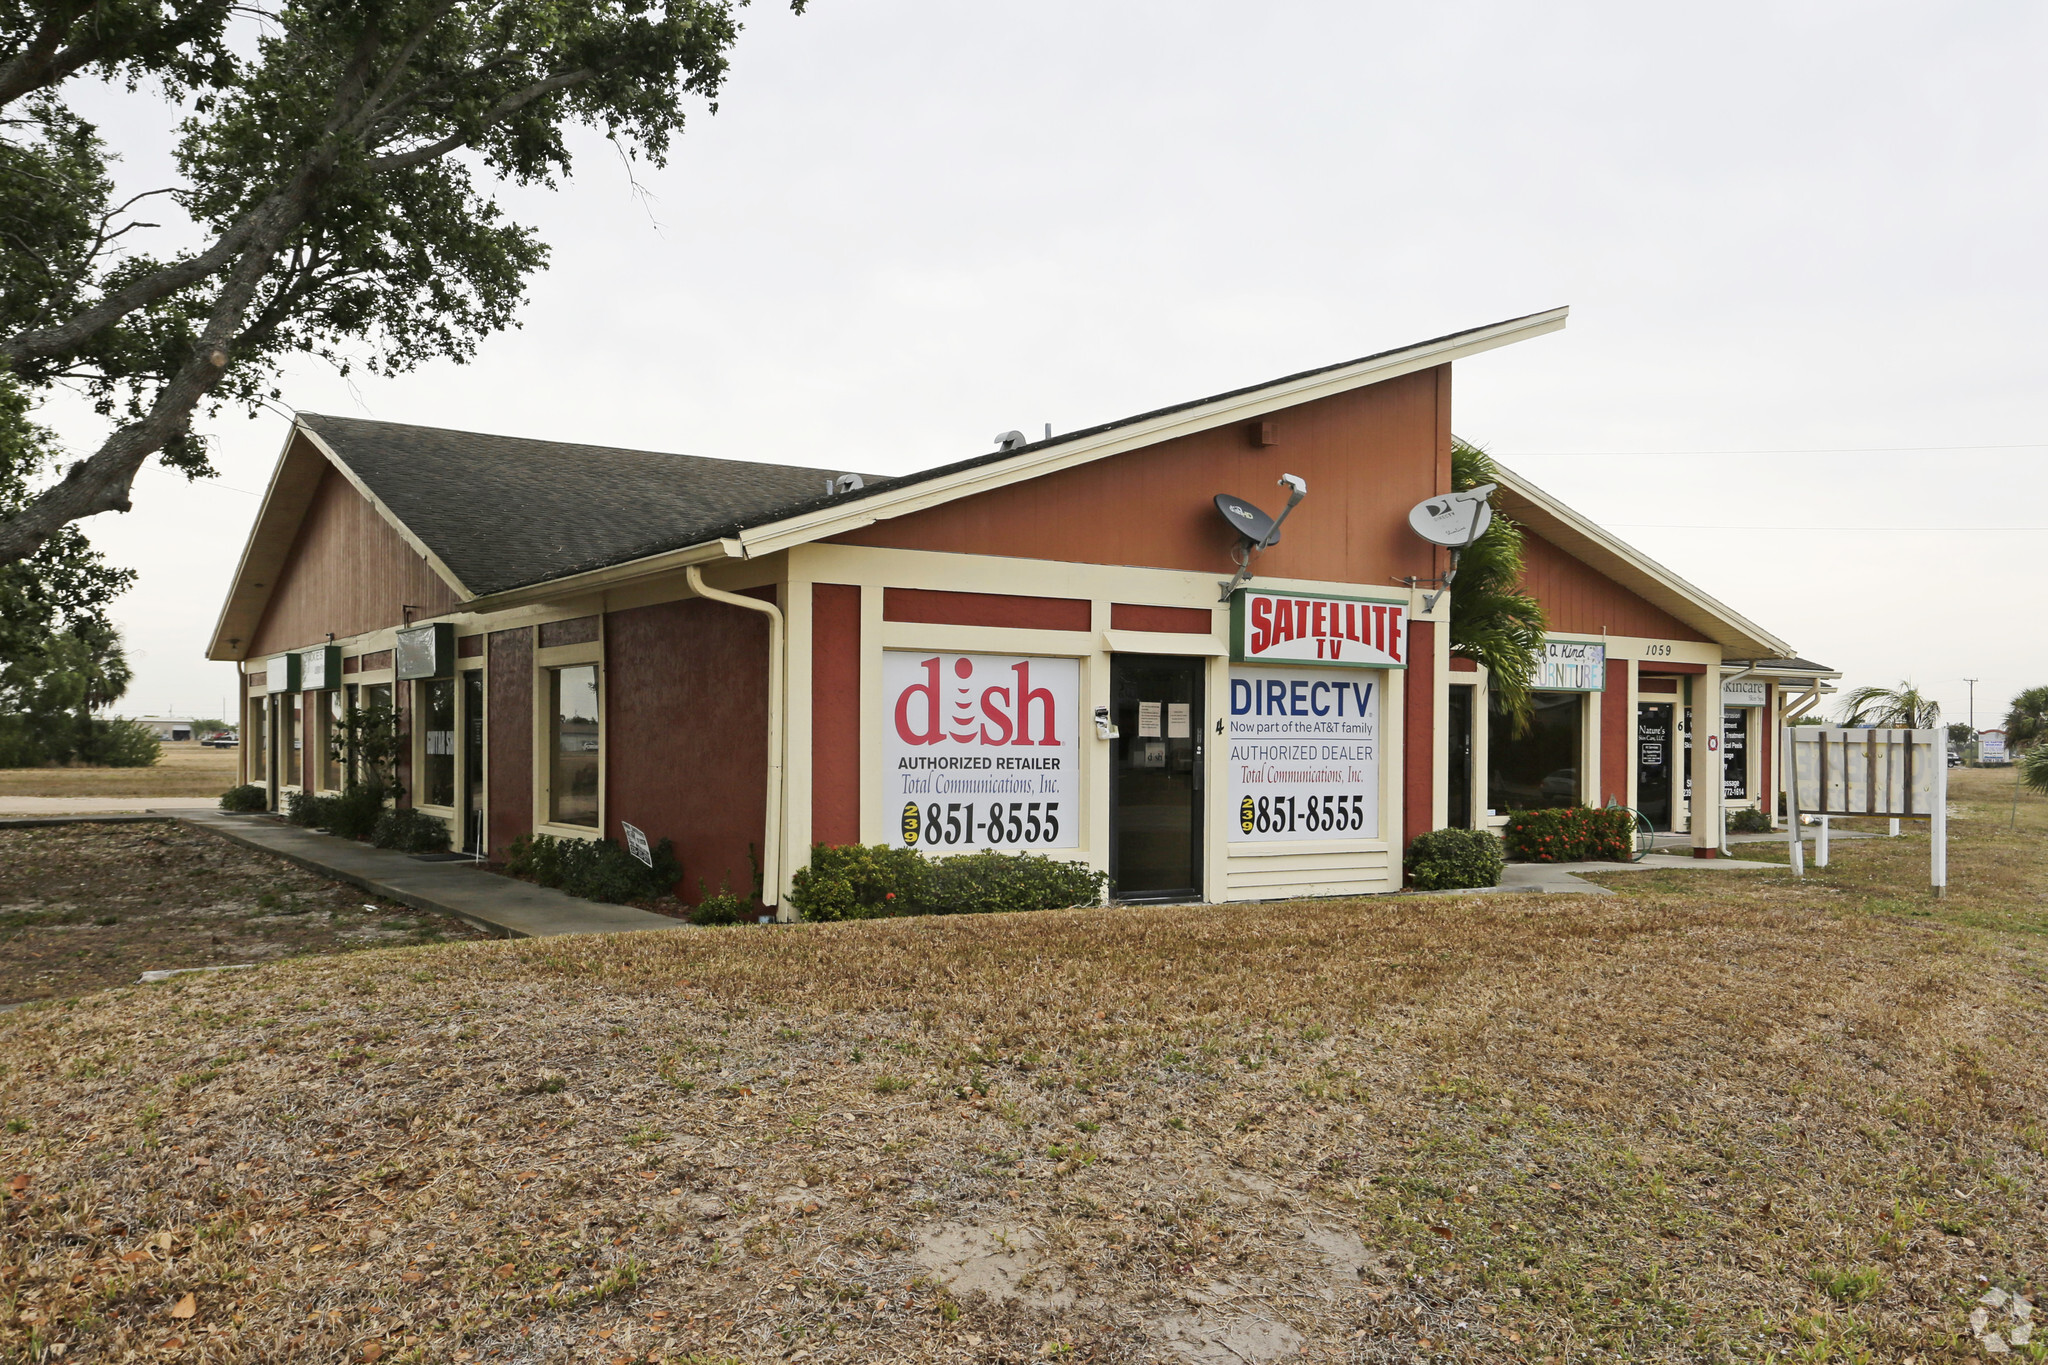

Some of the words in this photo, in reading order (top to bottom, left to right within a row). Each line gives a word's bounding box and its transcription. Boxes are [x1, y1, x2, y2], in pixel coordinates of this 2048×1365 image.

[1251, 597, 1402, 663] SATELLITE
[1316, 638, 1342, 659] TV
[1550, 644, 1558, 657] a
[1561, 644, 1587, 659] Kind
[1646, 644, 1671, 656] 1059
[1534, 663, 1599, 689] URNITURE
[1230, 678, 1373, 718] DIRECTV
[1724, 681, 1763, 694] kincare
[894, 656, 1061, 746] dish
[1215, 717, 1225, 735] 4
[1230, 721, 1255, 732] Now
[1257, 722, 1280, 735] part
[1281, 721, 1293, 733] of
[1295, 722, 1312, 733] the
[1313, 722, 1340, 733] AT&T
[1342, 722, 1373, 736] family
[1639, 724, 1666, 735] Nature's
[1677, 721, 1683, 732] 6
[898, 757, 992, 770] AUTHORIZED
[996, 757, 1061, 770] RETAILER
[1147, 751, 1163, 761] dsh
[1231, 745, 1317, 761] AUTHORIZED
[1322, 746, 1373, 761] DEALER
[902, 770, 934, 794] Total
[935, 774, 1034, 796] Communications,
[1039, 774, 1060, 794] Inc.
[1241, 762, 1266, 784] Total
[1267, 765, 1344, 784] Communications,
[1347, 765, 1364, 783] Inc.
[904, 805, 919, 843] 239
[924, 802, 1059, 845] 851-8555
[1242, 798, 1254, 831] 239
[1256, 795, 1364, 833] 851-8555
